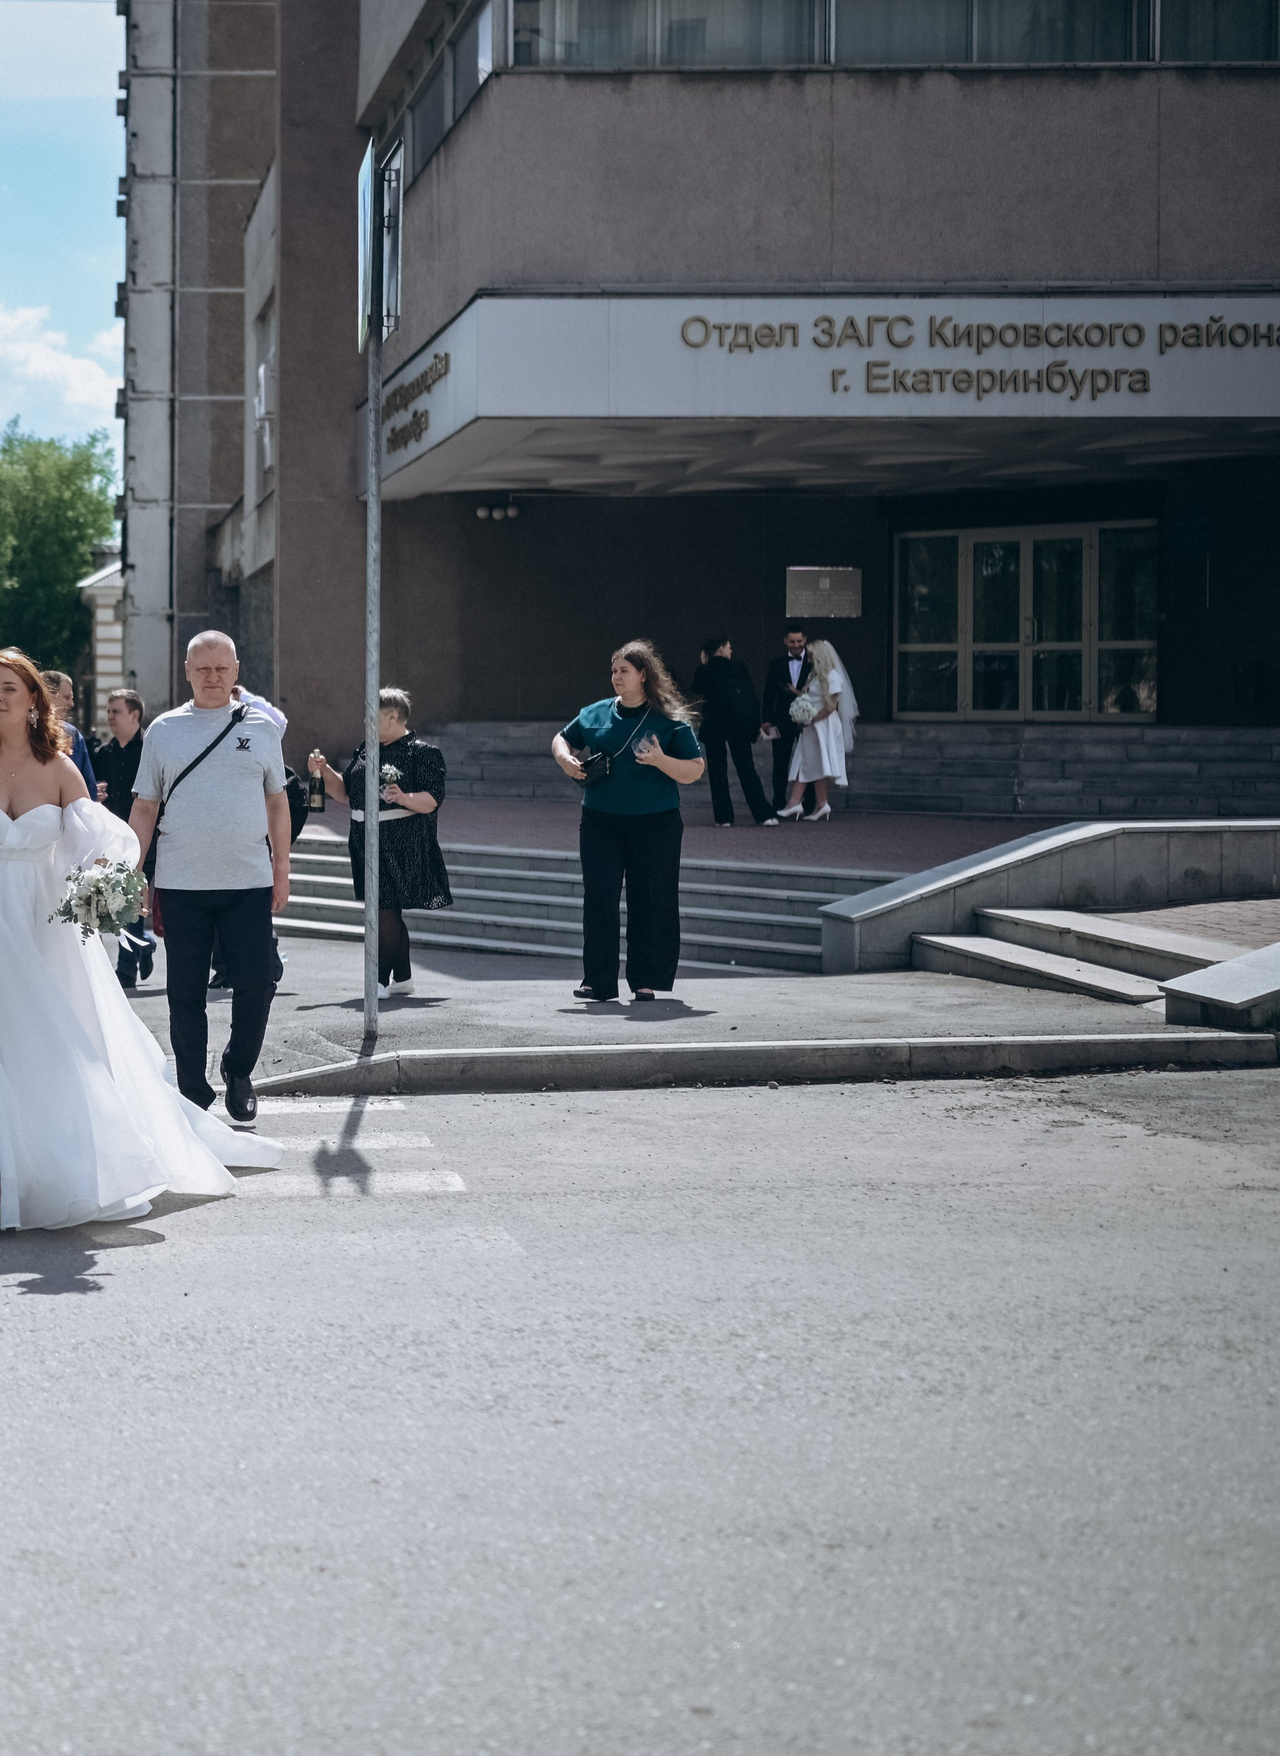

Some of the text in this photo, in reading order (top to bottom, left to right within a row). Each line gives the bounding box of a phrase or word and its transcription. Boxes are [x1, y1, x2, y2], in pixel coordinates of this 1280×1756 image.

[681, 315, 1280, 355] Отдел ЗАГС Кировского район
[832, 360, 1151, 400] г. Екатеринбурга
